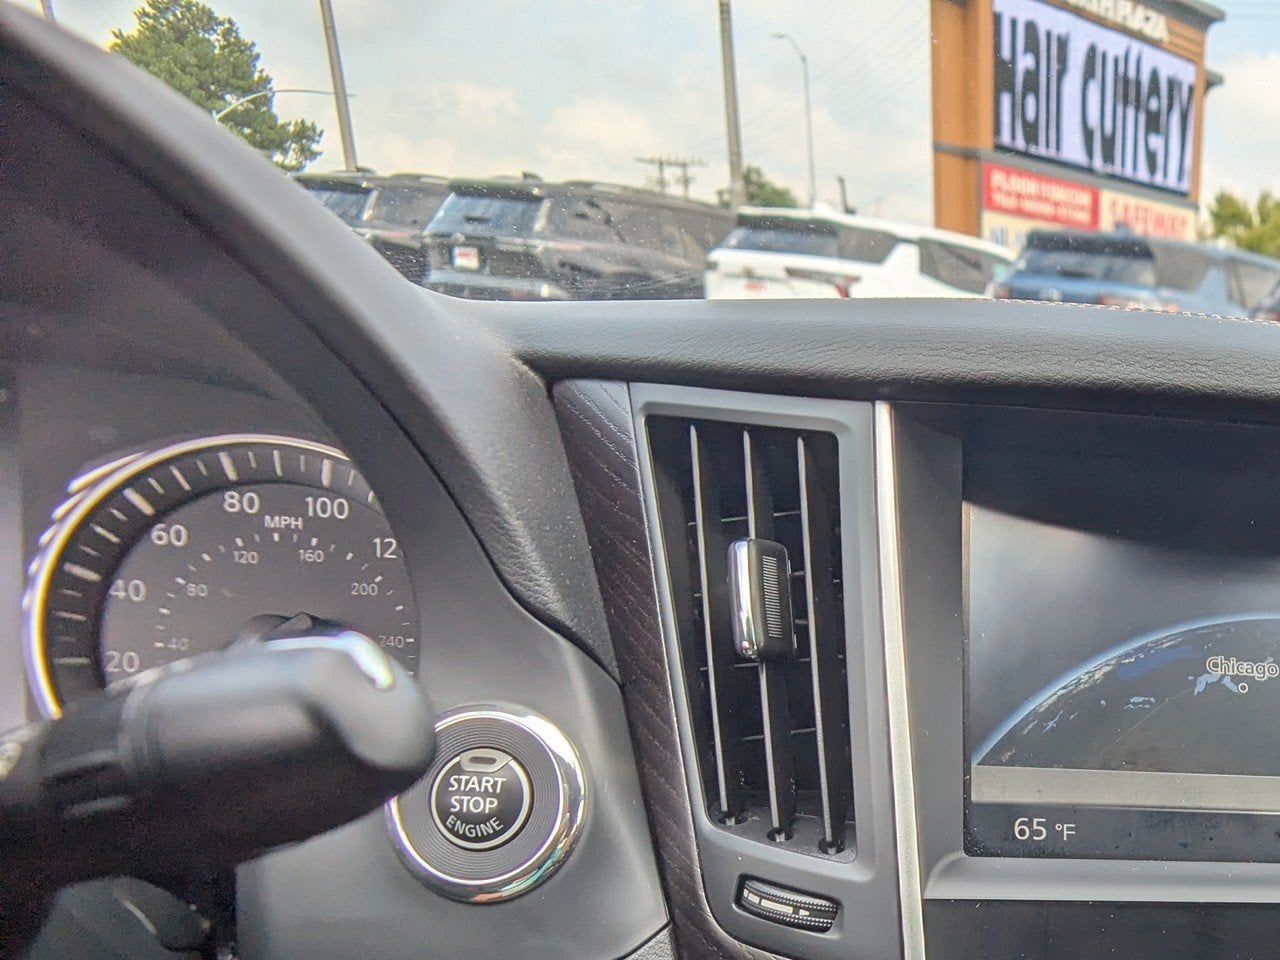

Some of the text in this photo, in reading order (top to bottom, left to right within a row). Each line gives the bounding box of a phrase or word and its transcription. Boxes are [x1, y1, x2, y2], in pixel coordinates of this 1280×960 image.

[223, 490, 261, 514] 80
[304, 496, 350, 520] 100
[264, 515, 303, 530] MPH
[150, 523, 189, 547] 60
[233, 550, 260, 564] 120
[298, 549, 325, 563] 160
[373, 537, 398, 559] 12
[108, 579, 146, 602] 40
[350, 582, 379, 597] 200
[105, 651, 141, 674] 20
[1206, 656, 1280, 682] Chicago
[448, 775, 507, 794] START
[450, 795, 499, 814] STOP
[445, 815, 504, 838] ENGINE
[1013, 817, 1047, 841] 65
